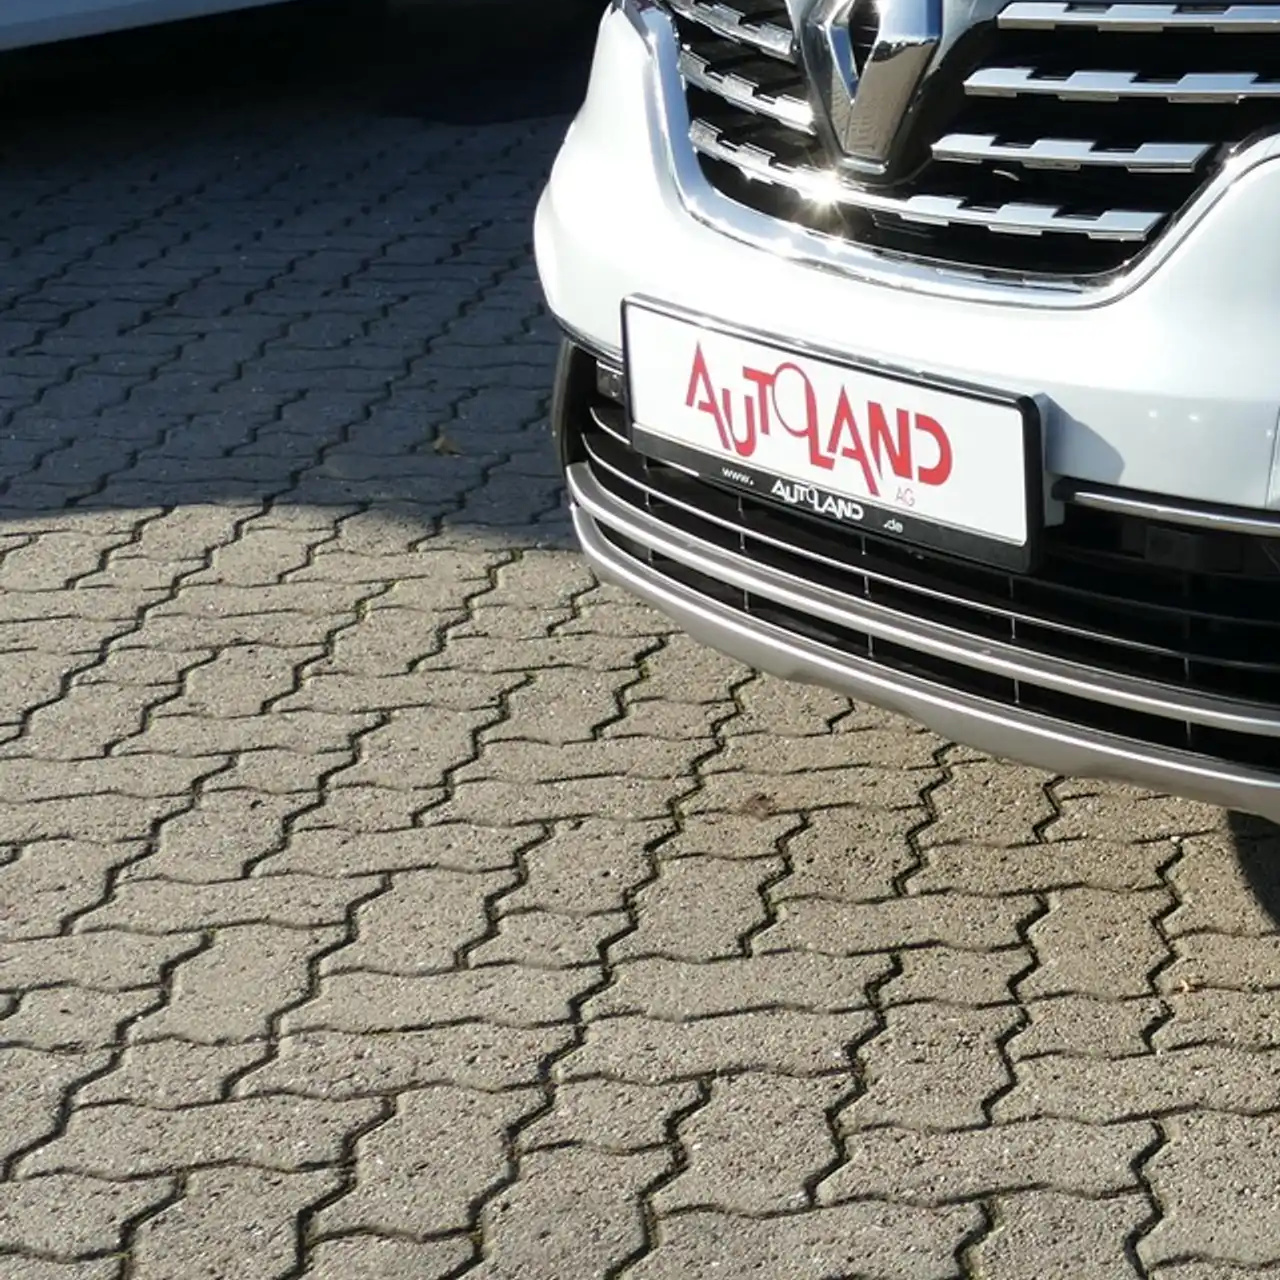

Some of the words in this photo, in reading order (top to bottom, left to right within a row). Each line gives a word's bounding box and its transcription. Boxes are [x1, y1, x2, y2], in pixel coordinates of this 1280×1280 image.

[686, 340, 954, 497] AUTOLAND
[771, 479, 864, 521] AUTOLAND
[895, 486, 916, 508] AG
